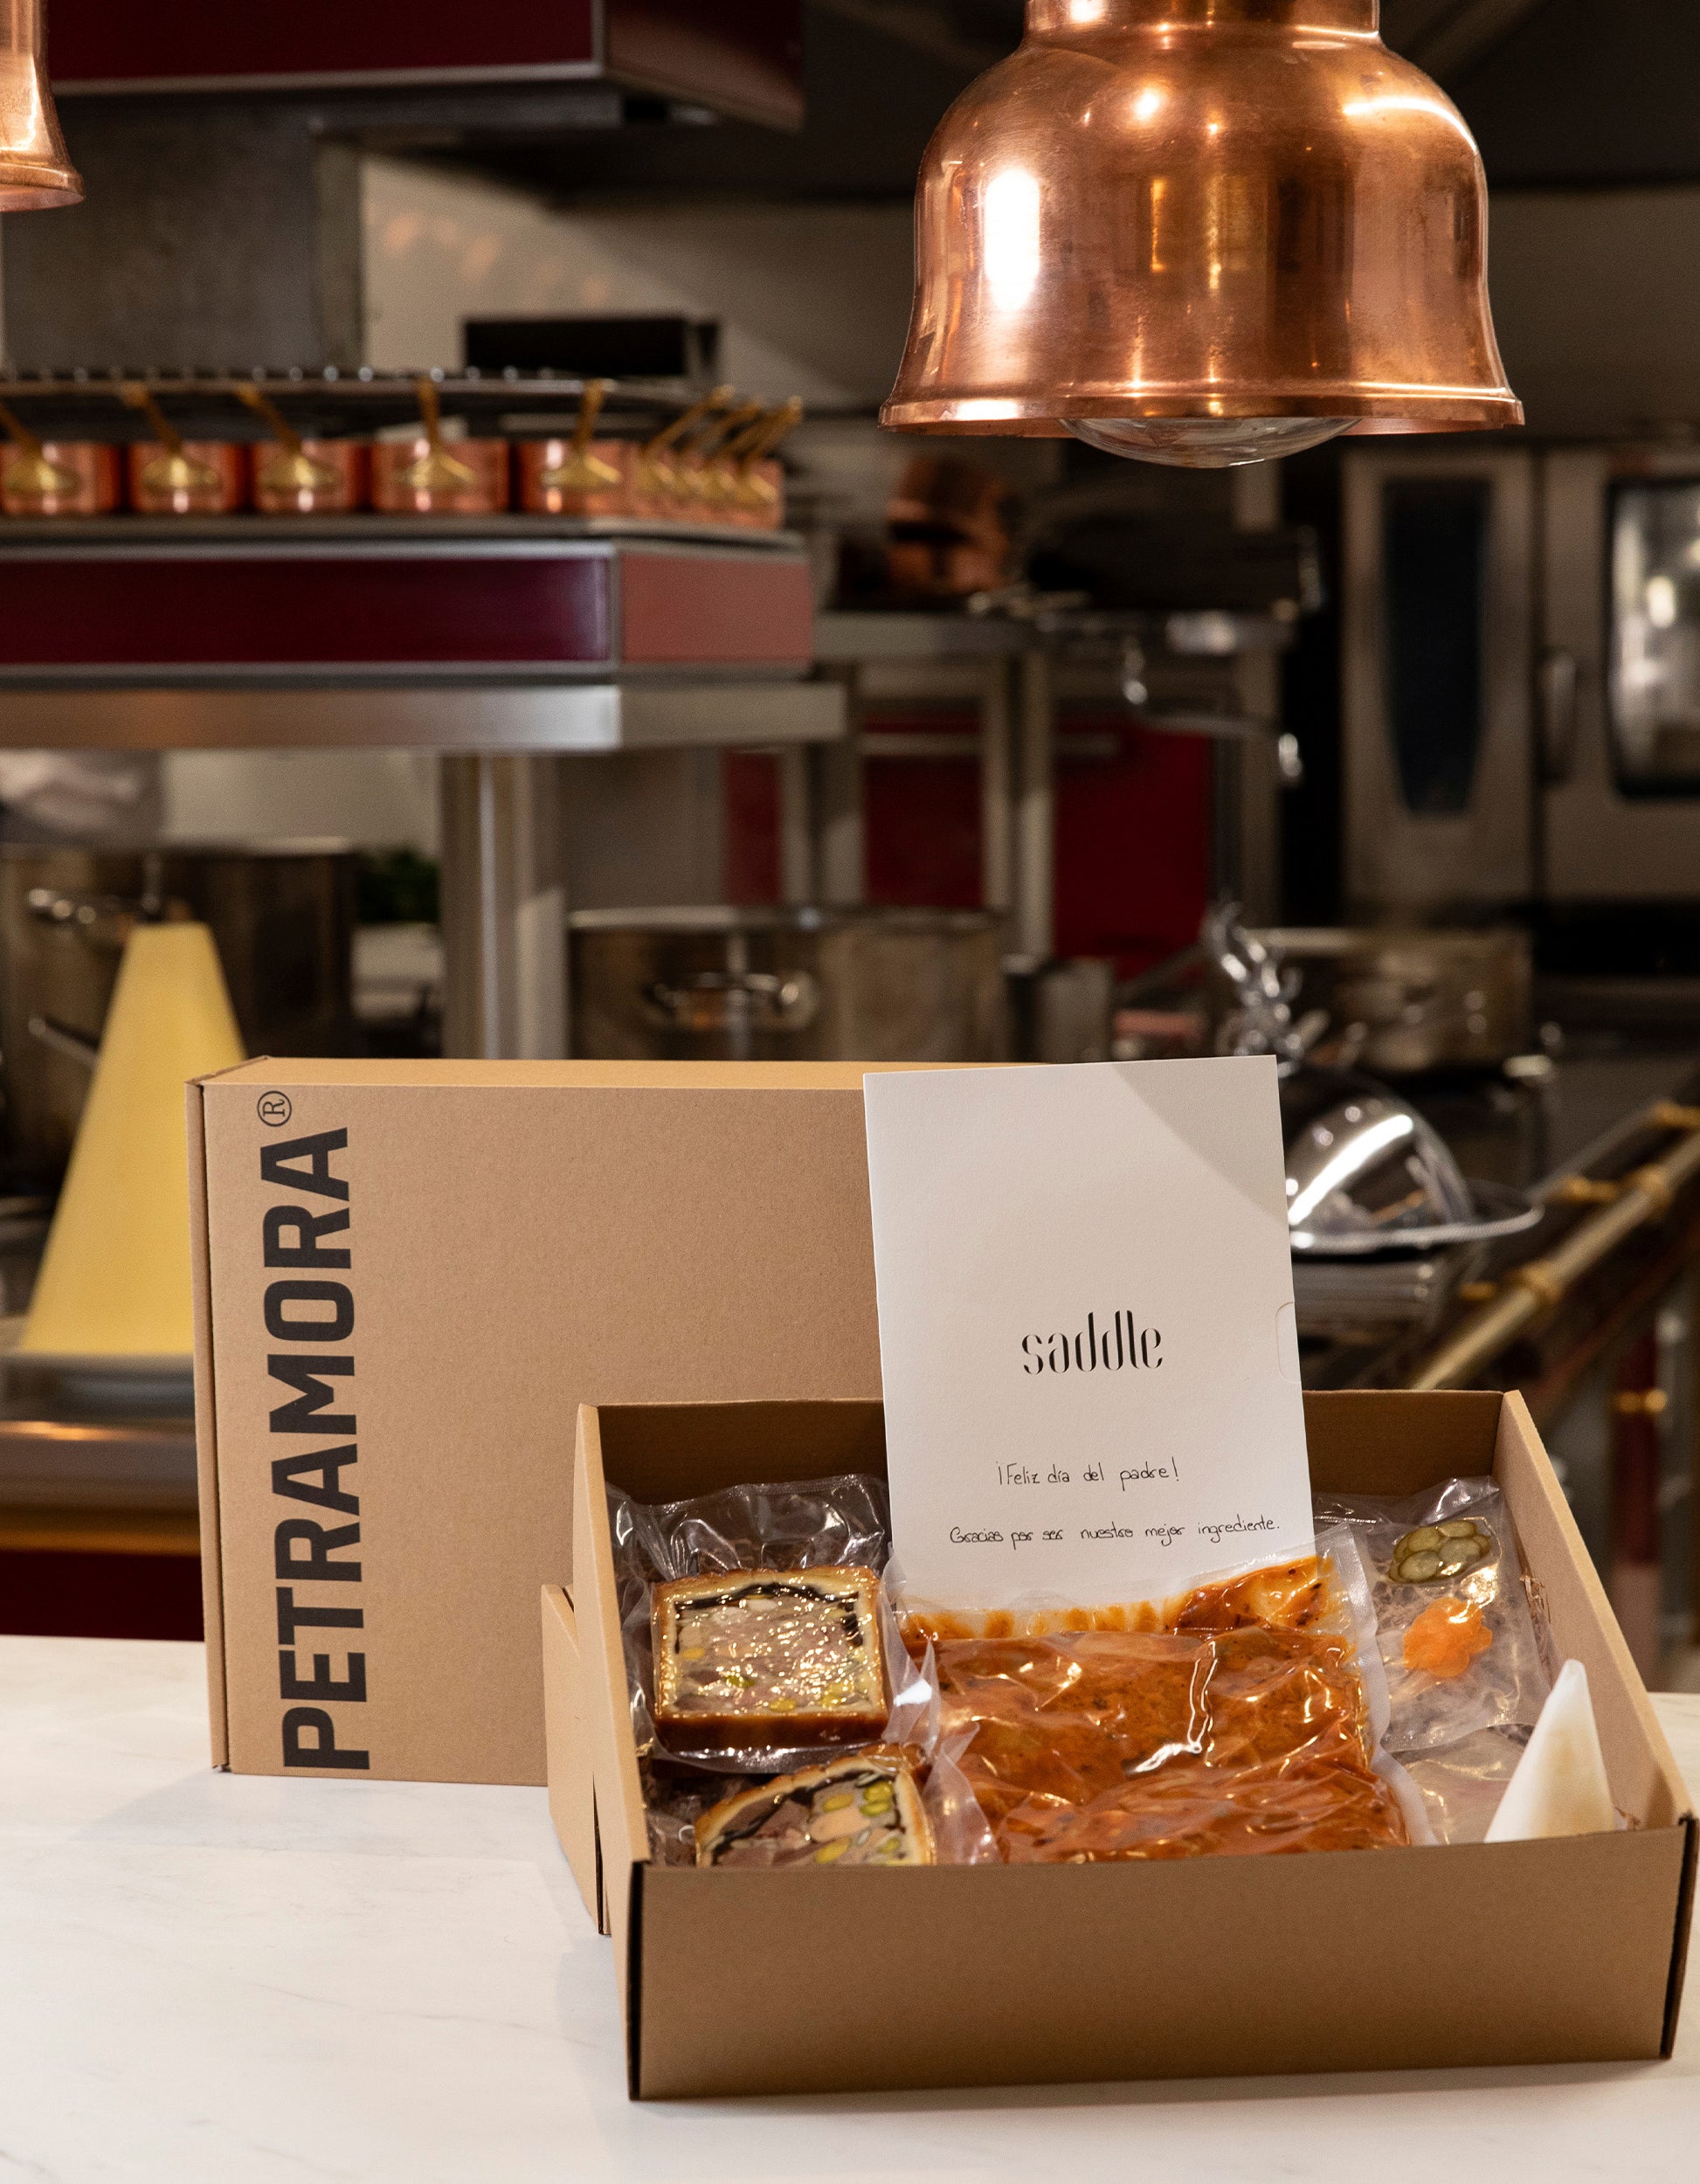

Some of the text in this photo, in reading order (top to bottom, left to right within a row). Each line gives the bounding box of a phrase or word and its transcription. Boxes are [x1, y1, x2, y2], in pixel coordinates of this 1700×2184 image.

[1021, 1310, 1164, 1375] saddle
[995, 1456, 1179, 1491] ¡Feliz día del padre!
[950, 1514, 1280, 1551] Gracias por ser nuestro mejor ingrediente.
